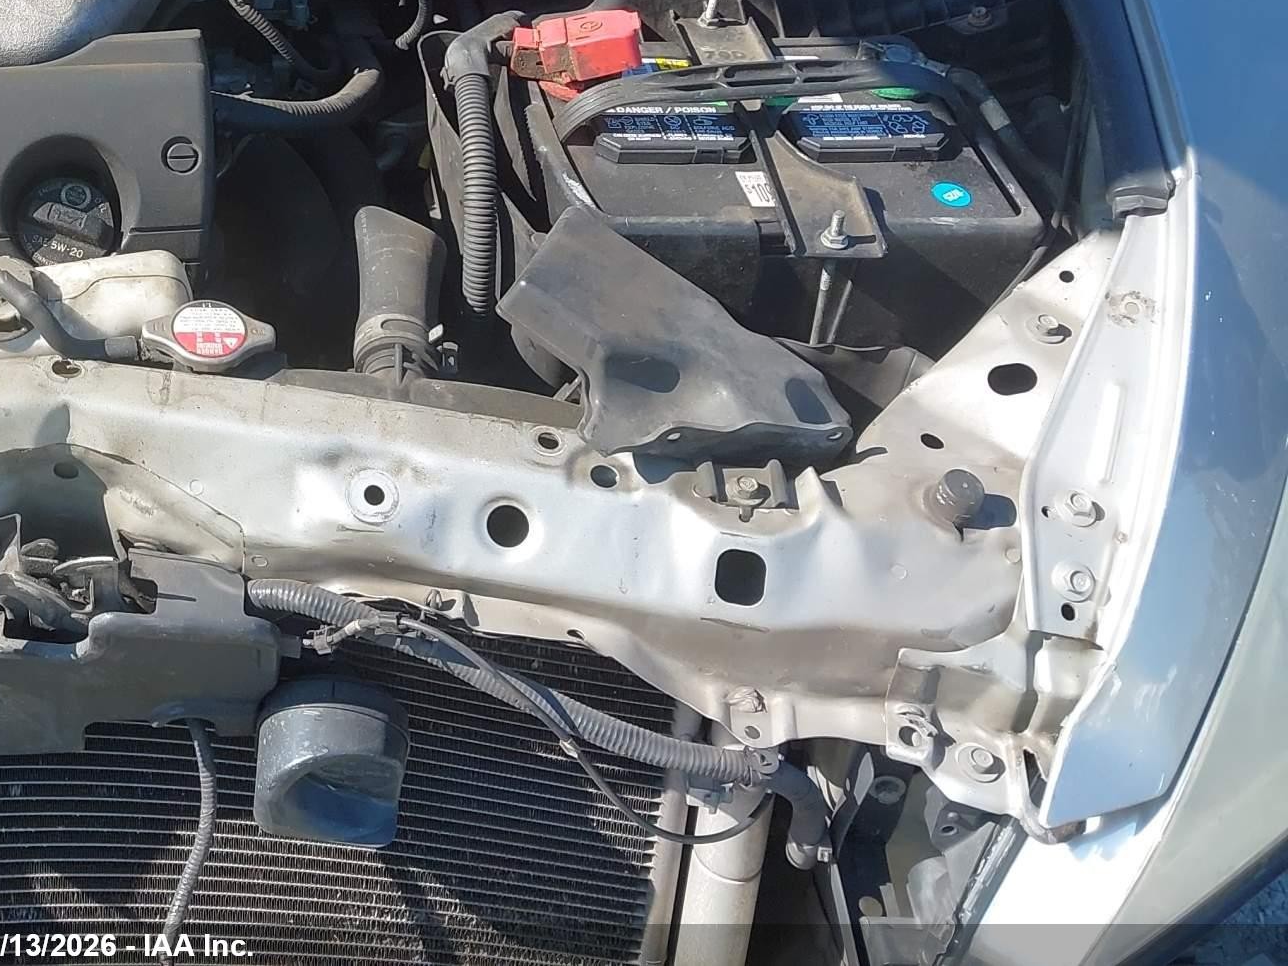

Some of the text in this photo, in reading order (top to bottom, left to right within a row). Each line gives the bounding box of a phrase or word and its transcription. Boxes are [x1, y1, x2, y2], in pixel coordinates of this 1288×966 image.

[615, 106, 663, 114] DANGER
[674, 106, 717, 114] POISON
[32, 234, 84, 259] SAE 5W-20
